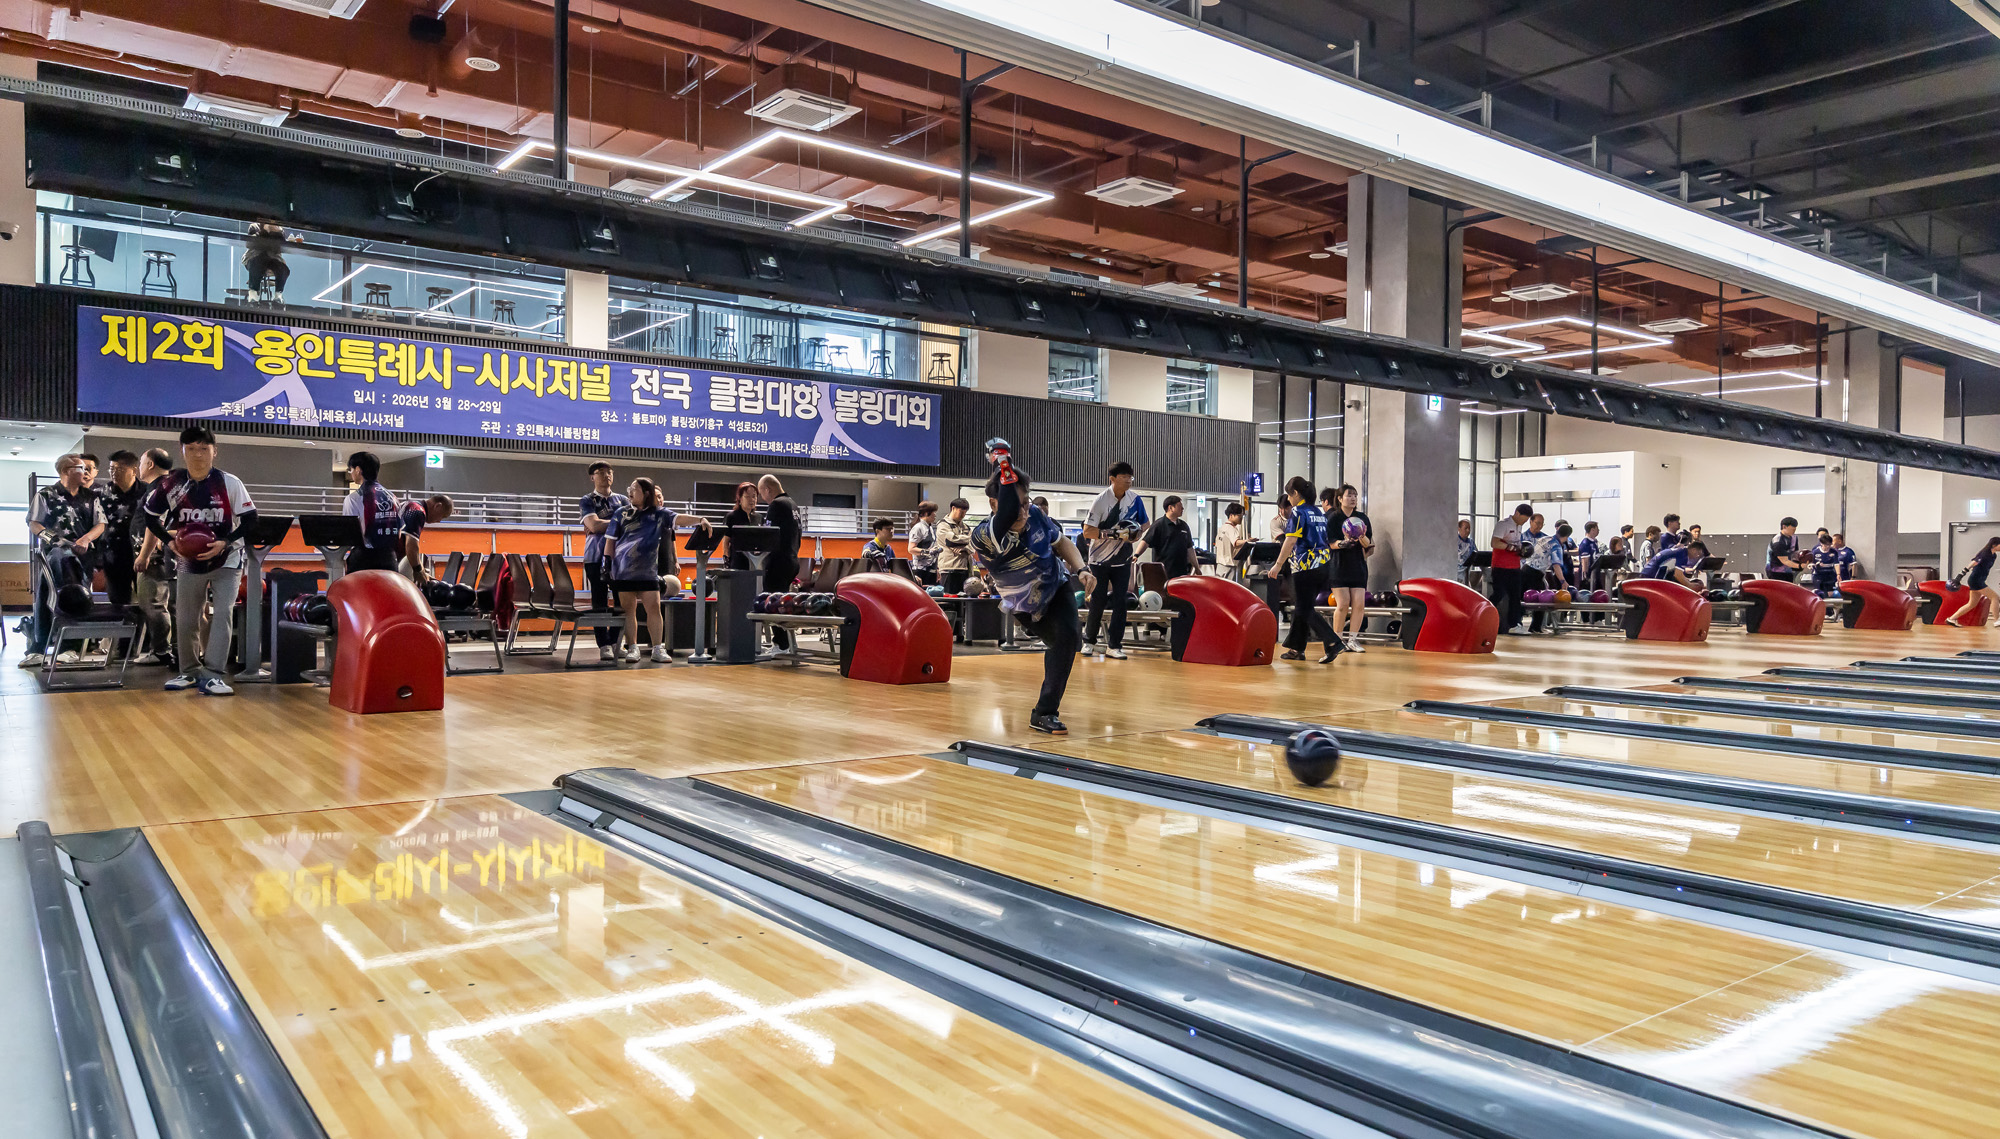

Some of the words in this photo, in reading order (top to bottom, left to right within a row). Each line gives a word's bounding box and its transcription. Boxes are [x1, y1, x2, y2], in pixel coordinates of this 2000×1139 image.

[100, 314, 224, 371] 제2회
[251, 329, 612, 402] 용인특례시-시사저널
[630, 367, 693, 410] 전국
[708, 375, 822, 420] 클럽대항
[834, 387, 931, 431] 볼링대회
[353, 389, 375, 404] 일시
[392, 393, 429, 409] 2026년
[434, 396, 452, 411] 3월
[457, 399, 501, 414] 28~29일
[220, 402, 245, 418] 주최
[263, 405, 404, 428] 용인특례시체육회,시사저널
[600, 410, 619, 422] 장소
[631, 412, 667, 426] 볼토피아
[727, 419, 768, 434] 석성로521)
[480, 420, 501, 434] 주관
[515, 423, 600, 441] 용인특례시볼링협회
[664, 433, 682, 446] 후원
[179, 507, 225, 523] STORM
